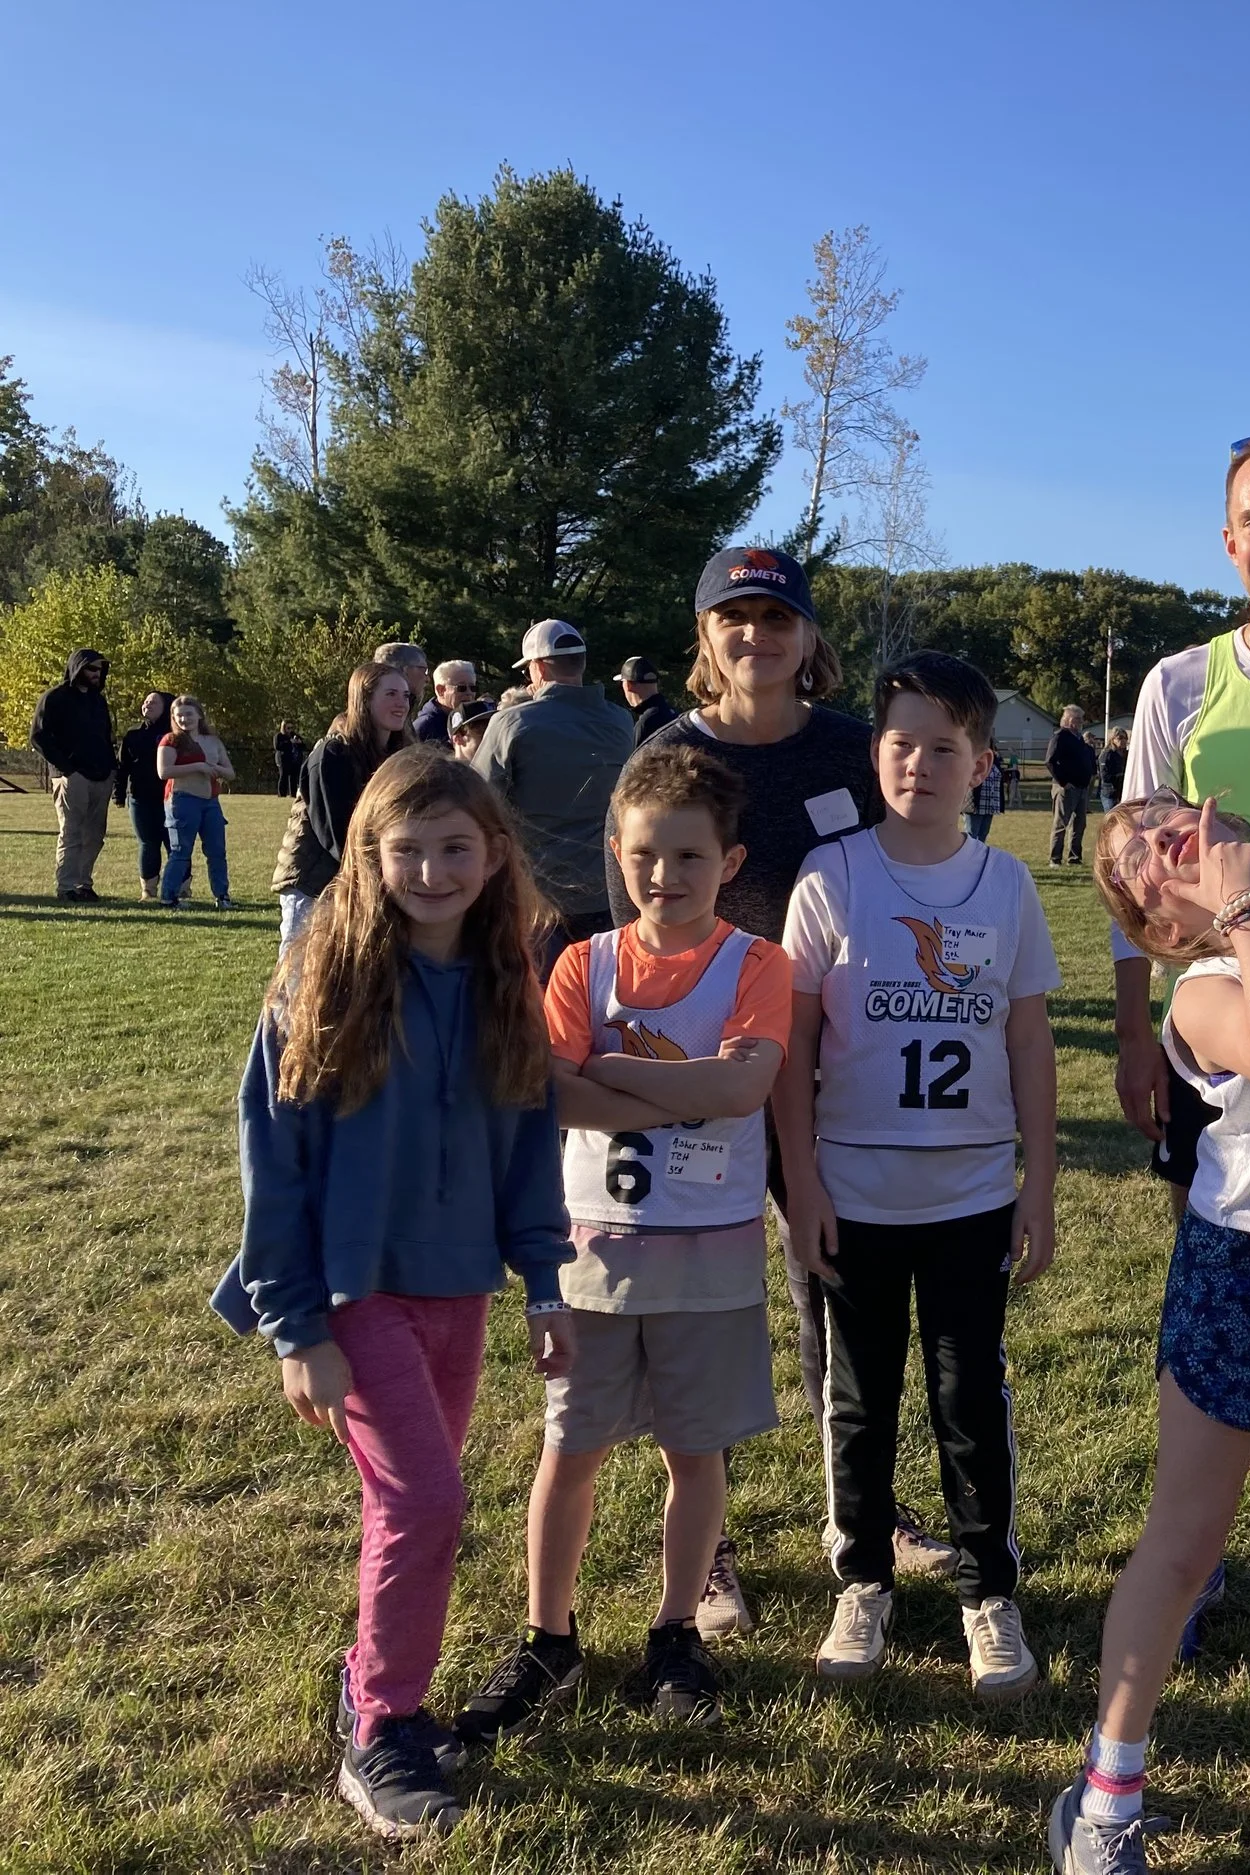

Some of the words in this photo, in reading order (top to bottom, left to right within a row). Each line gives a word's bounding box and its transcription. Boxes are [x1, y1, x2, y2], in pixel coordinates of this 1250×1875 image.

[729, 568, 787, 584] COMETS
[943, 940, 959, 948] TCH
[865, 989, 993, 1025] COMETS
[899, 1038, 971, 1110] 12
[672, 1137, 698, 1150] Asher
[671, 1151, 690, 1161] TCH
[606, 1131, 654, 1205] 6
